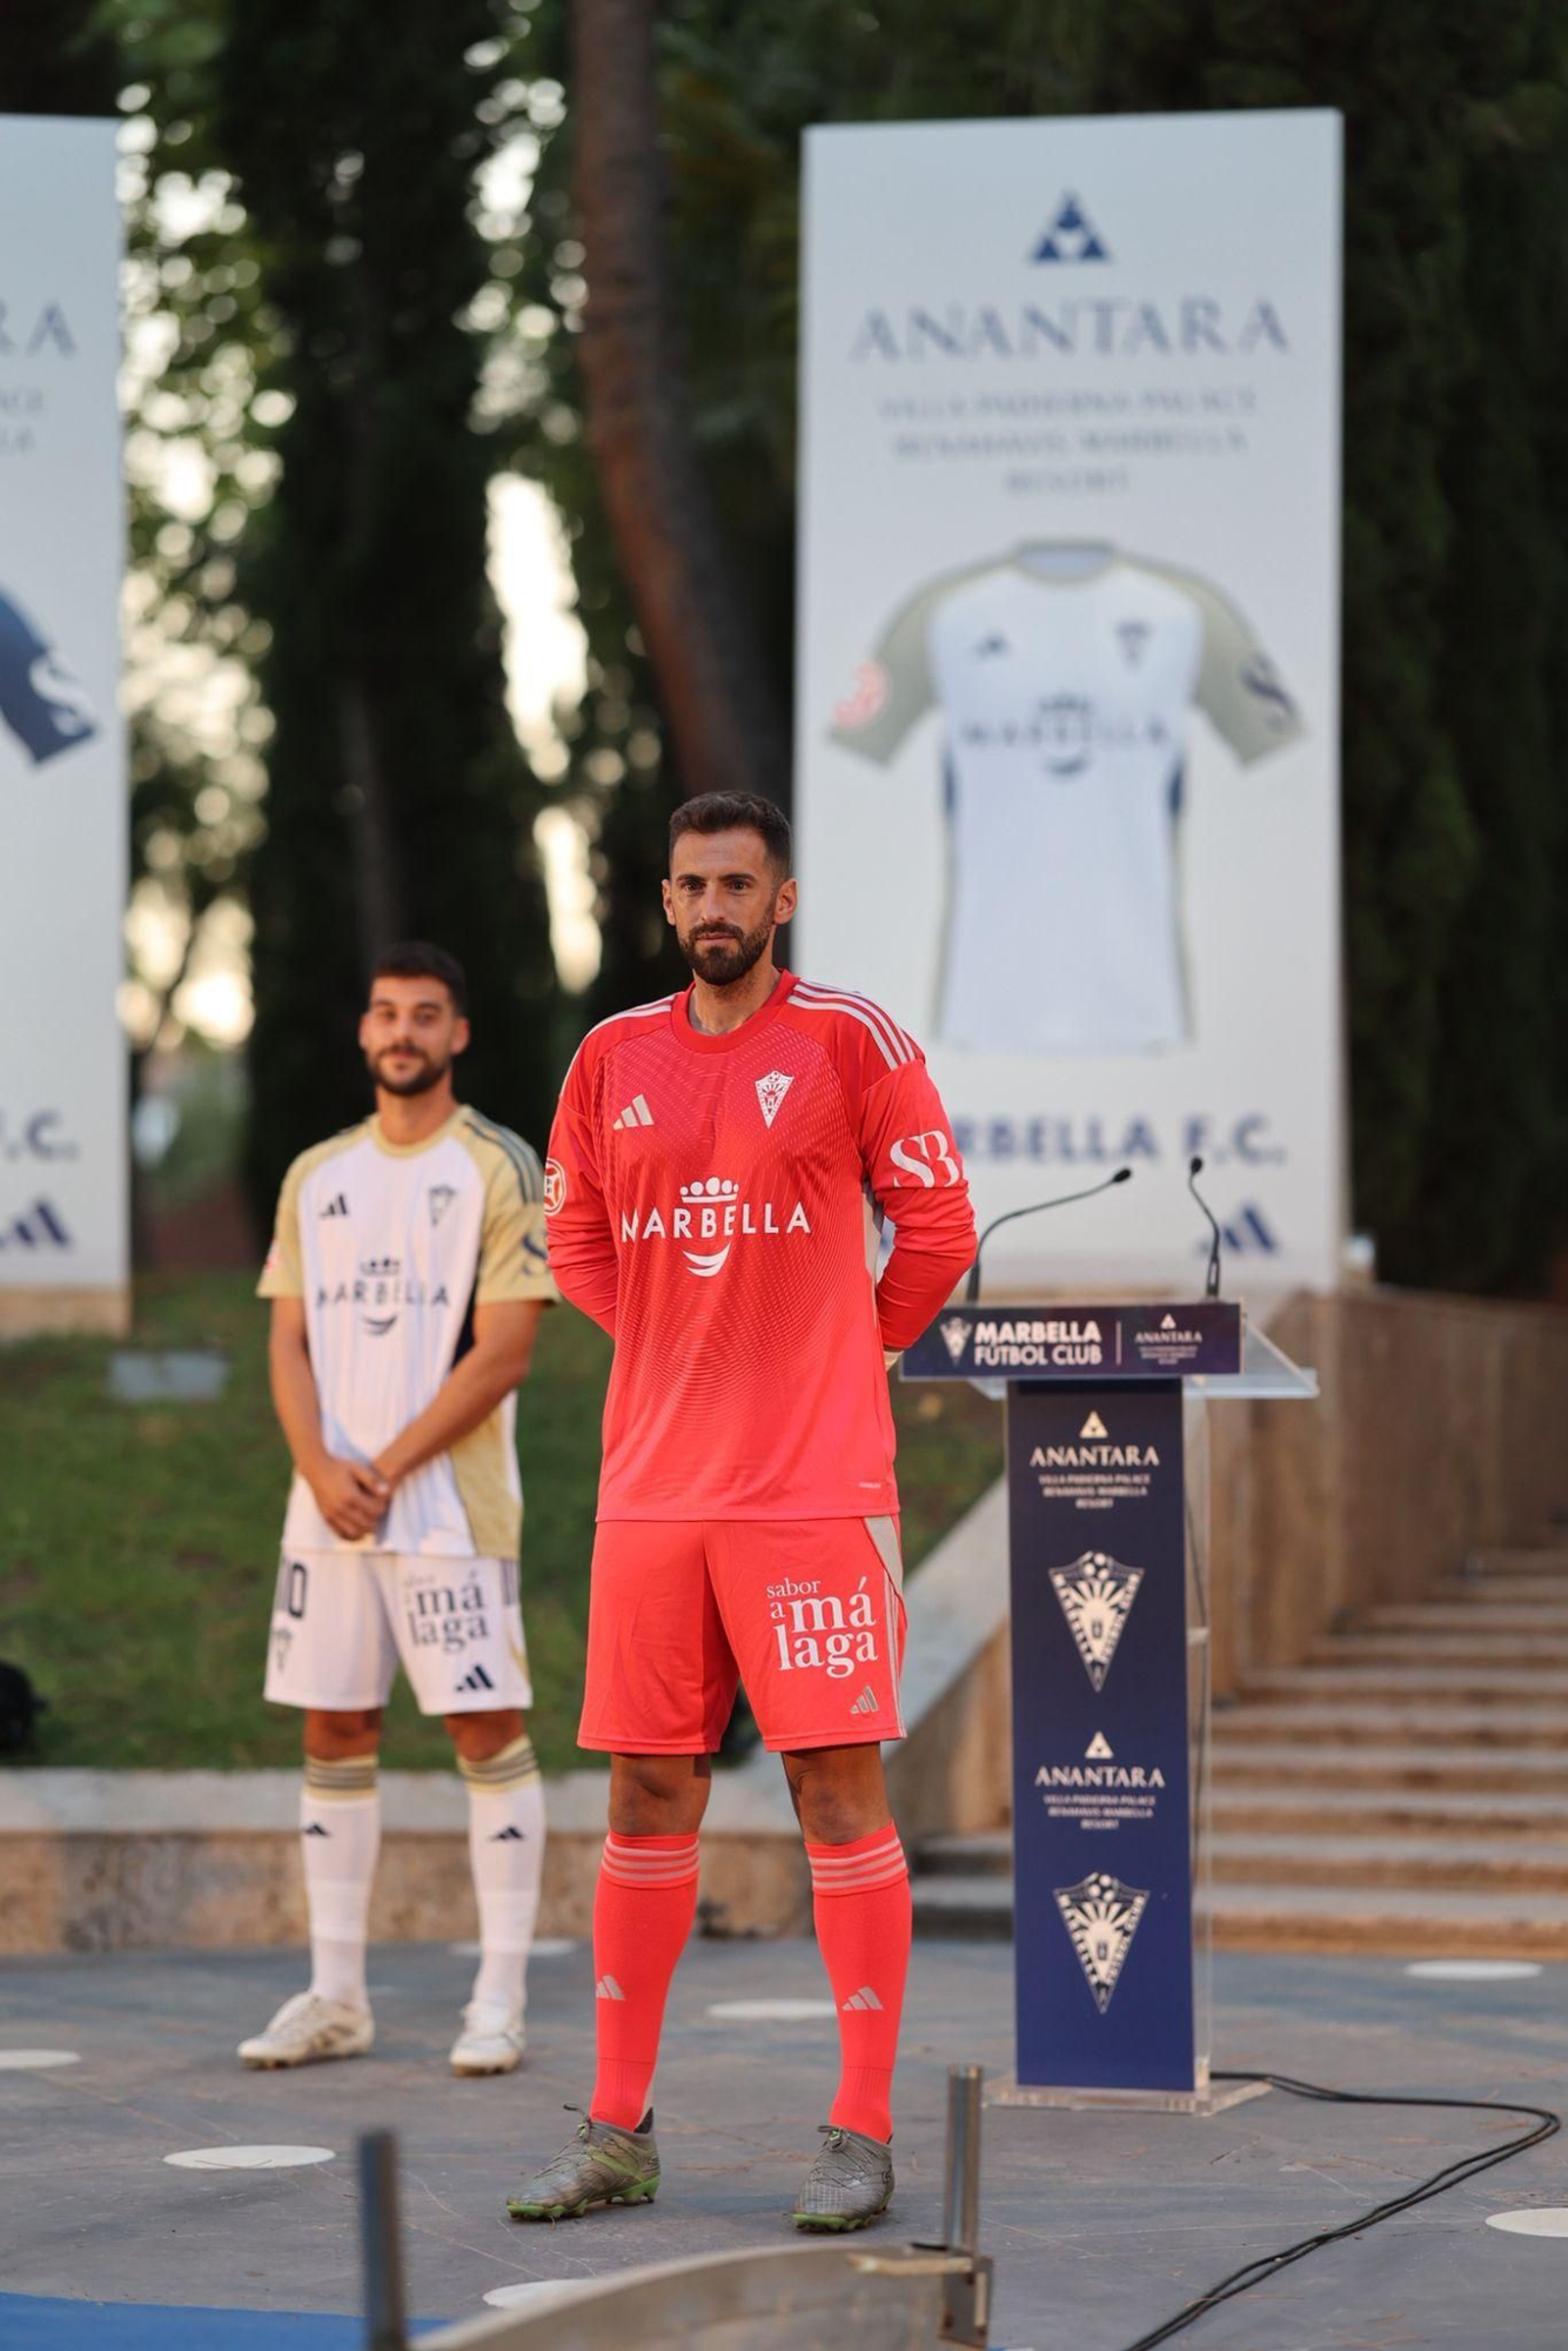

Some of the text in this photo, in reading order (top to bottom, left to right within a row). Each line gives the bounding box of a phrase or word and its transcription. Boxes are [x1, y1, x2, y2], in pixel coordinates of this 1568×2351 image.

[851, 297, 1289, 363] ANANTARA
[951, 1112, 1161, 1160] RBELLA
[974, 1320, 1102, 1344] MARBELLA
[1134, 1330, 1203, 1344] ANANTARA
[1052, 1344, 1102, 1365] CLUB
[1029, 1445, 1159, 1467] ANANTARA
[765, 1577, 821, 1599] sabor
[770, 1576, 877, 1634] a má
[773, 1623, 879, 1679] laga
[1035, 1765, 1166, 1788] ANANTARA
